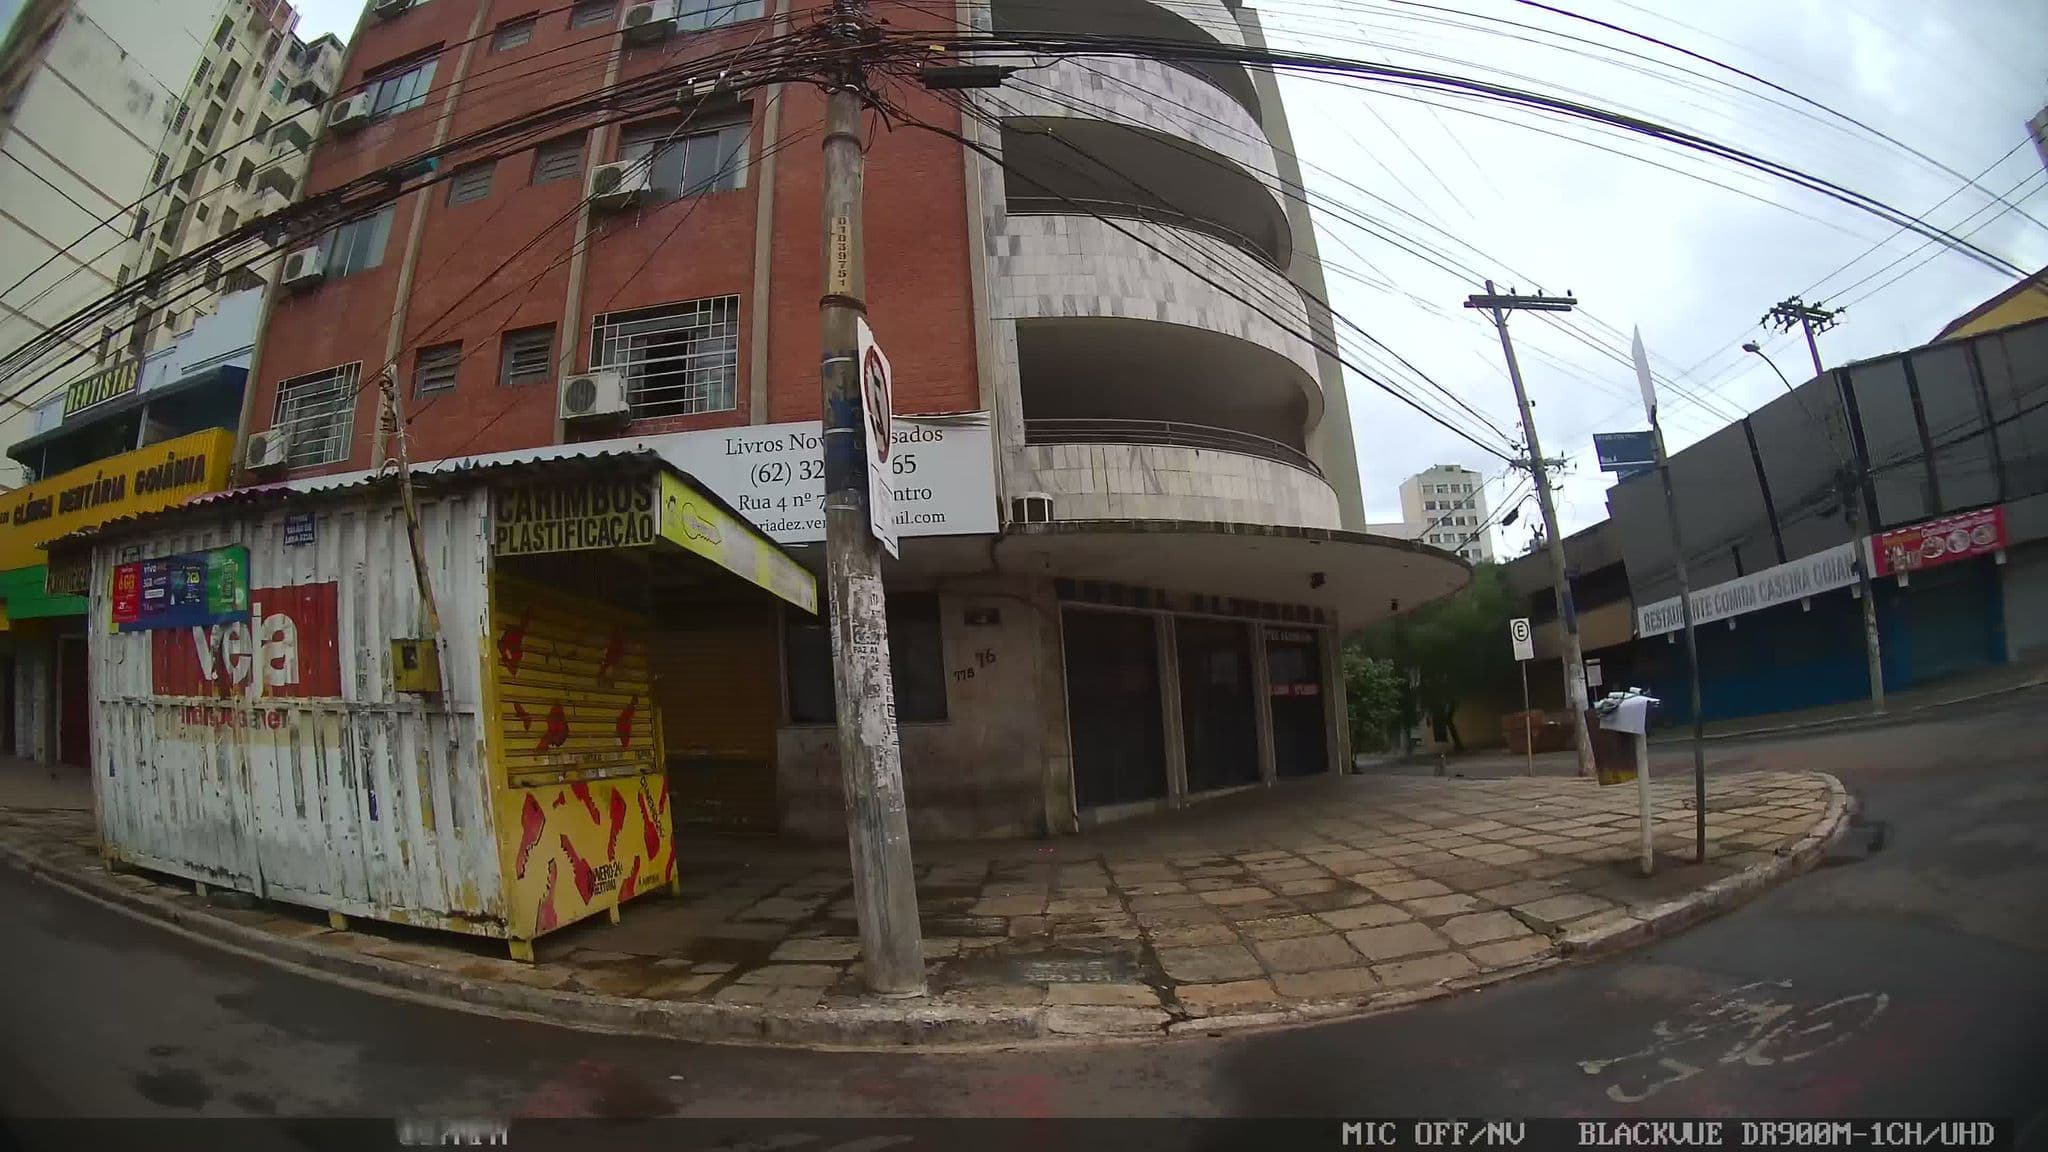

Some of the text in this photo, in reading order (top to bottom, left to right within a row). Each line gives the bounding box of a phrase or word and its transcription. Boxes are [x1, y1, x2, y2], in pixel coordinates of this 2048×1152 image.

[66, 361, 138, 413] DENTISTAS
[725, 425, 943, 455] Livros Nov sados
[751, 461, 792, 488] (62)
[497, 475, 653, 523] CARIMBOS
[739, 495, 771, 511] Rua
[777, 497, 788, 512] 4
[893, 487, 932, 501] ntro
